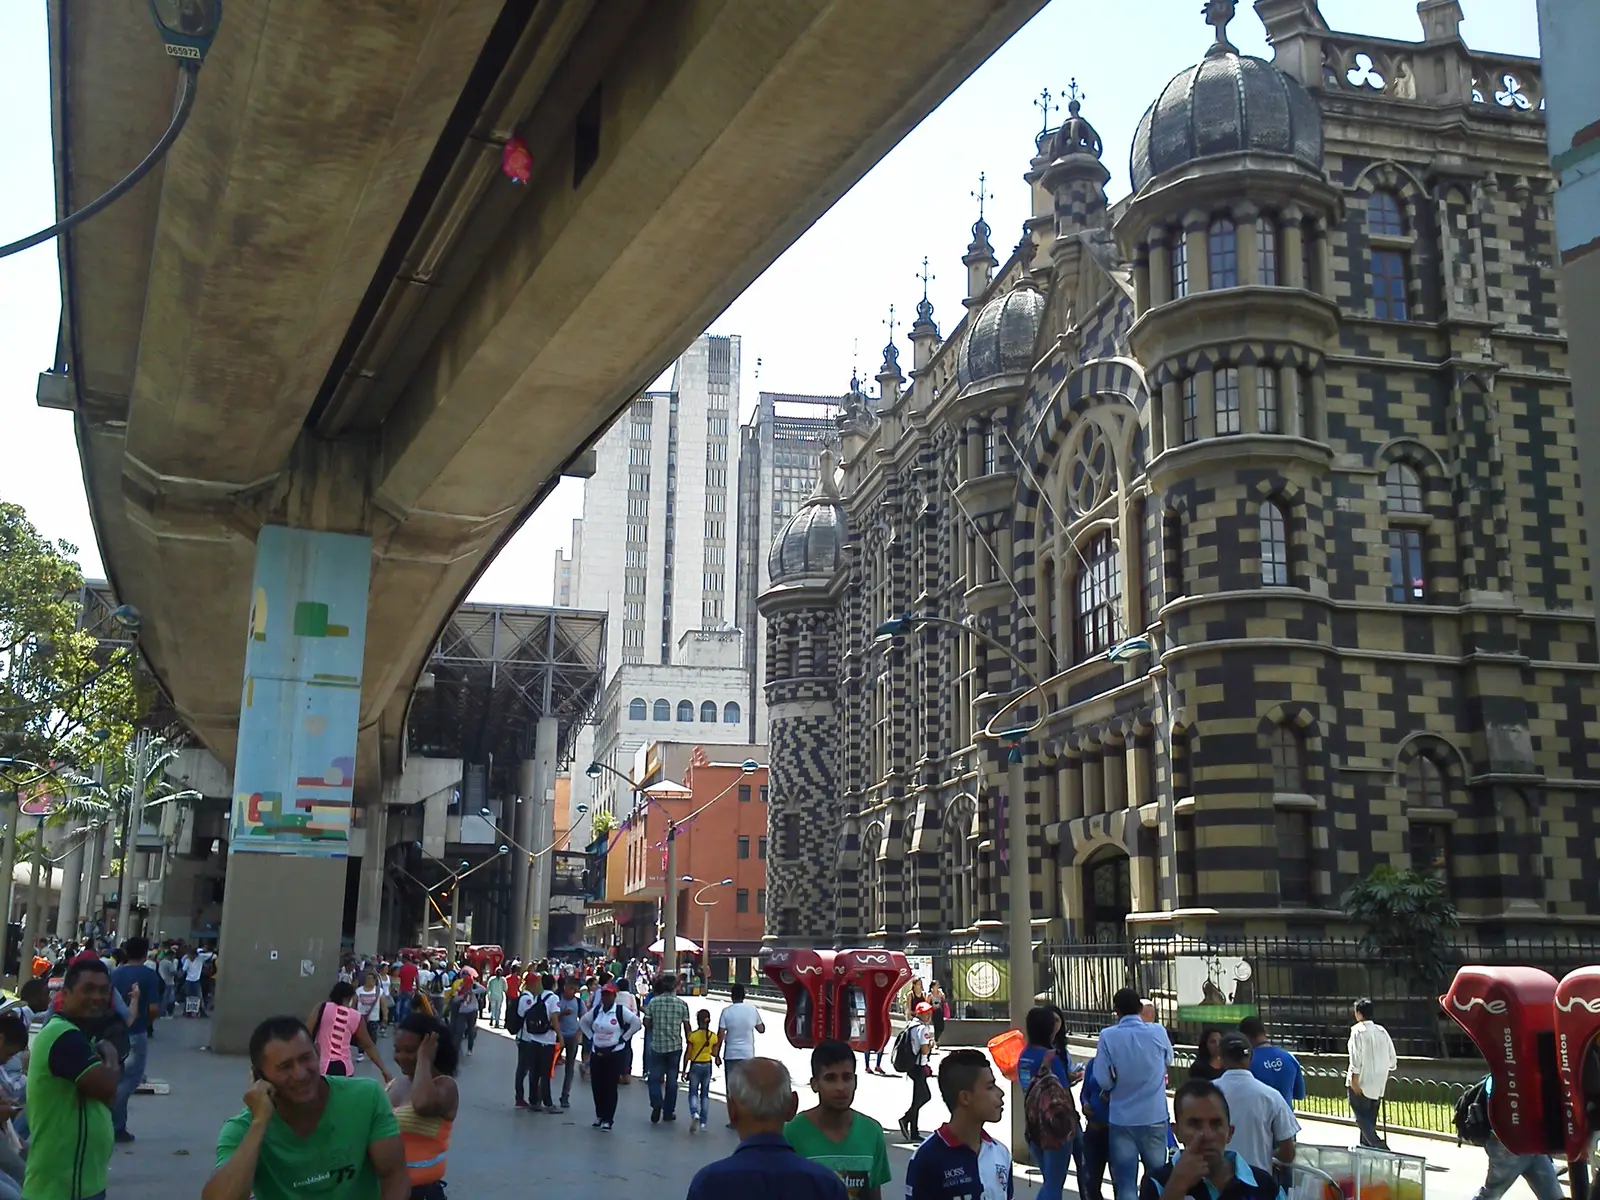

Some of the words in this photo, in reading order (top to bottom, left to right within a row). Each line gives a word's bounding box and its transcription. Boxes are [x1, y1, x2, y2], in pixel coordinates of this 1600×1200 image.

[856, 954, 887, 964] une
[796, 964, 822, 975] une
[1453, 995, 1507, 1014] une
[1504, 1027, 1516, 1064] juntos
[1560, 1034, 1571, 1072] juntos
[1508, 1071, 1519, 1124] mejor
[943, 1167, 965, 1178] BOSS
